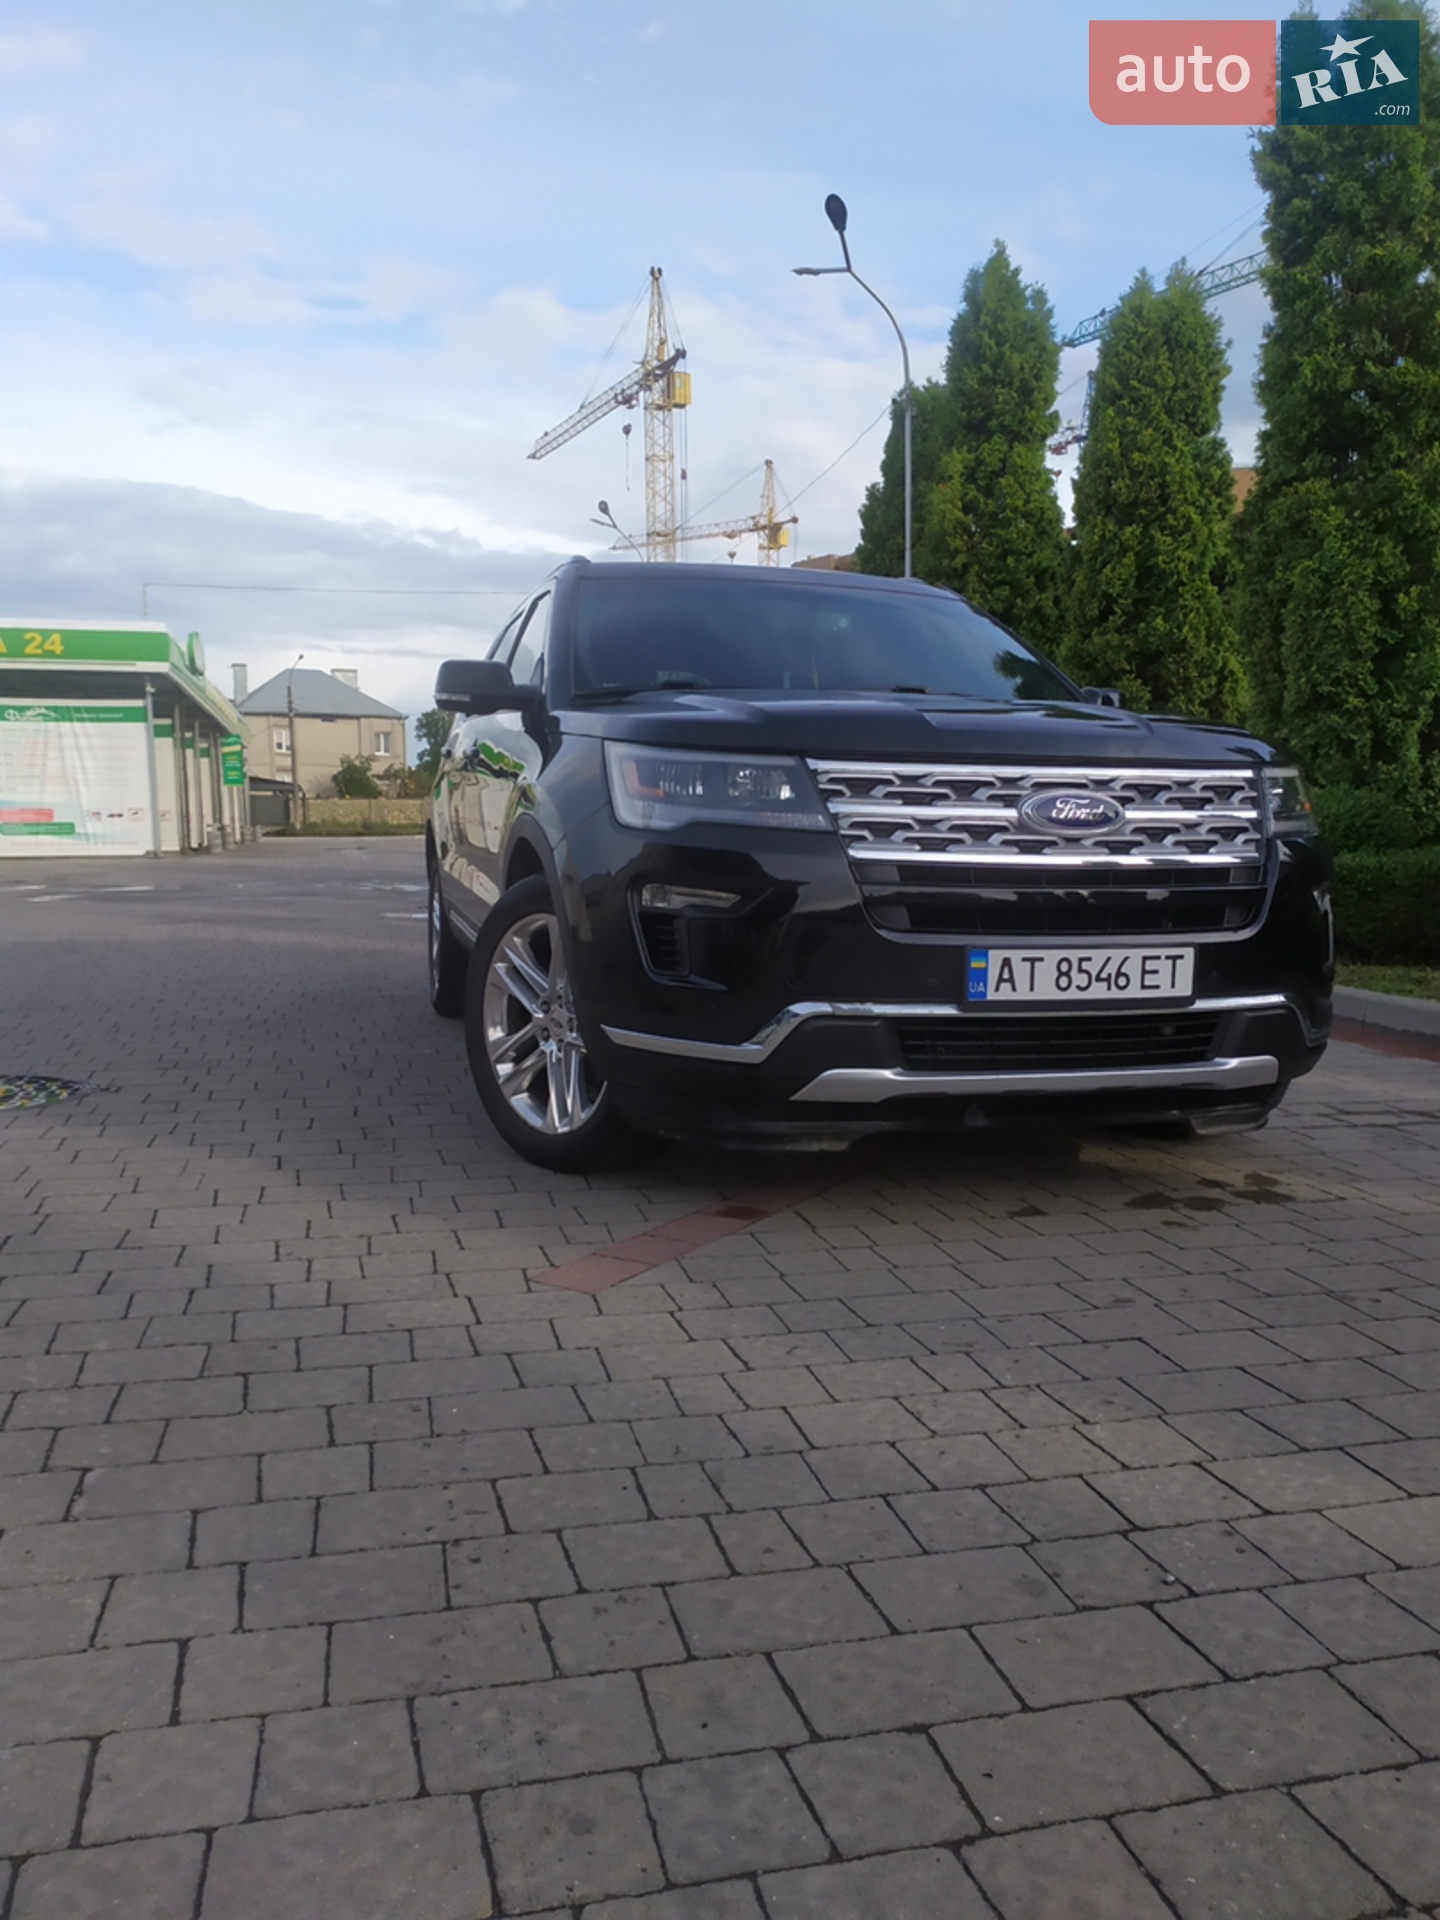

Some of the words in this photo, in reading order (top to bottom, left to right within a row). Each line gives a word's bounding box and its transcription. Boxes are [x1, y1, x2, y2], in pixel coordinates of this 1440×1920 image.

[23, 632, 65, 655] 24
[1051, 797, 1107, 821] Ford
[994, 956, 1045, 993] AT
[1054, 955, 1131, 993] 8546
[1140, 954, 1185, 991] ET
[968, 981, 986, 993] UA
